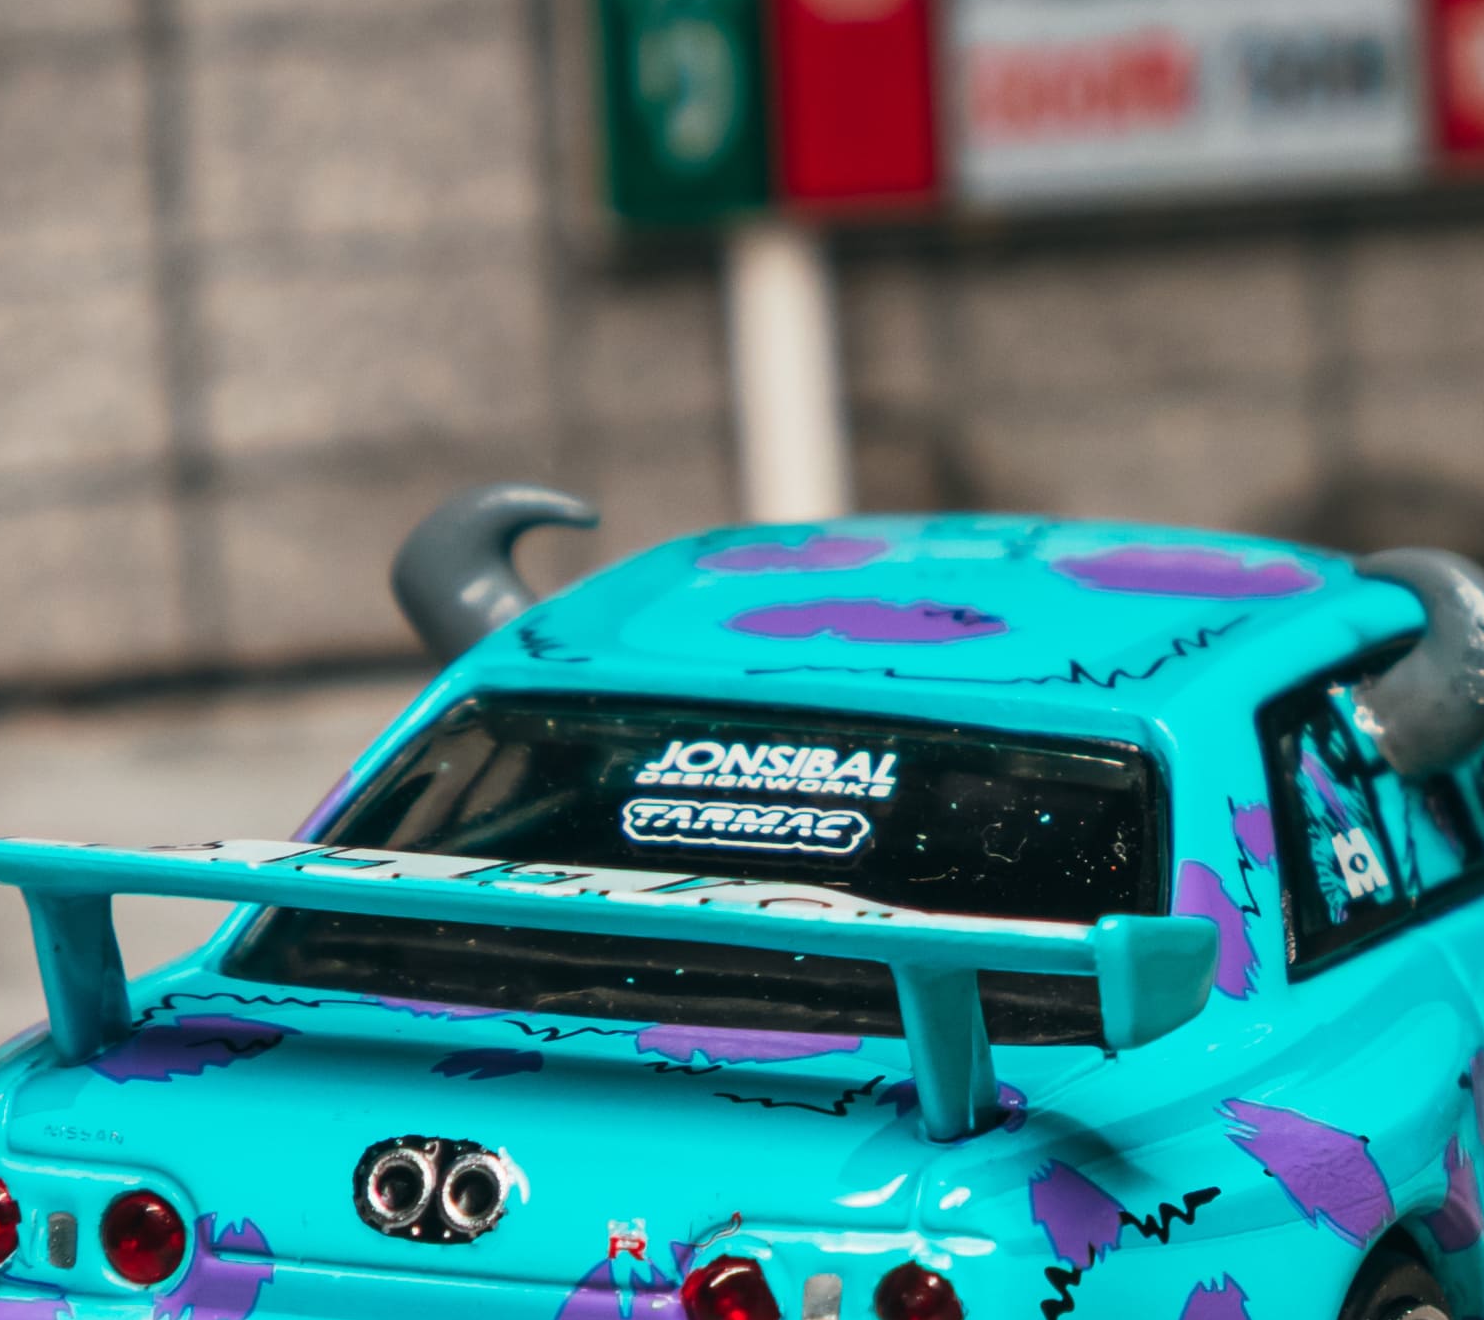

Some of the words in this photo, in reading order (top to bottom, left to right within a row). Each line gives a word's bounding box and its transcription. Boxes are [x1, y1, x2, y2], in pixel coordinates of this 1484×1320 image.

[645, 740, 896, 785] JONSIBAL
[635, 771, 892, 797] DESIGNWORKS
[630, 803, 856, 841] TARMAC
